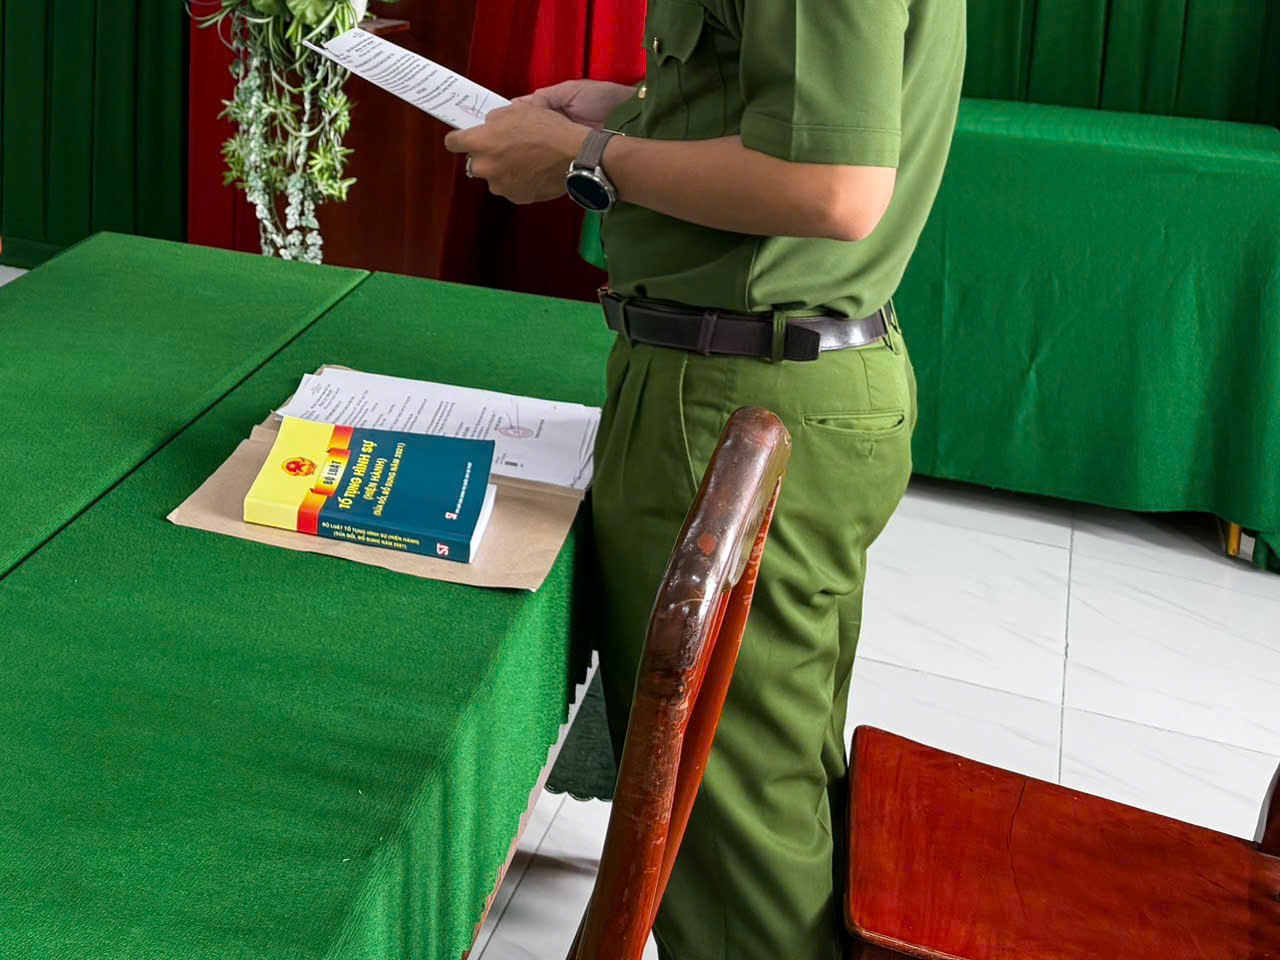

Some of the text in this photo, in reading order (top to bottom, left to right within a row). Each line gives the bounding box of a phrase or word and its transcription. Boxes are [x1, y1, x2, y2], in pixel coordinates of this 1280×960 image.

[338, 440, 377, 509] TỐ TỤNG HÌNH SỰ
